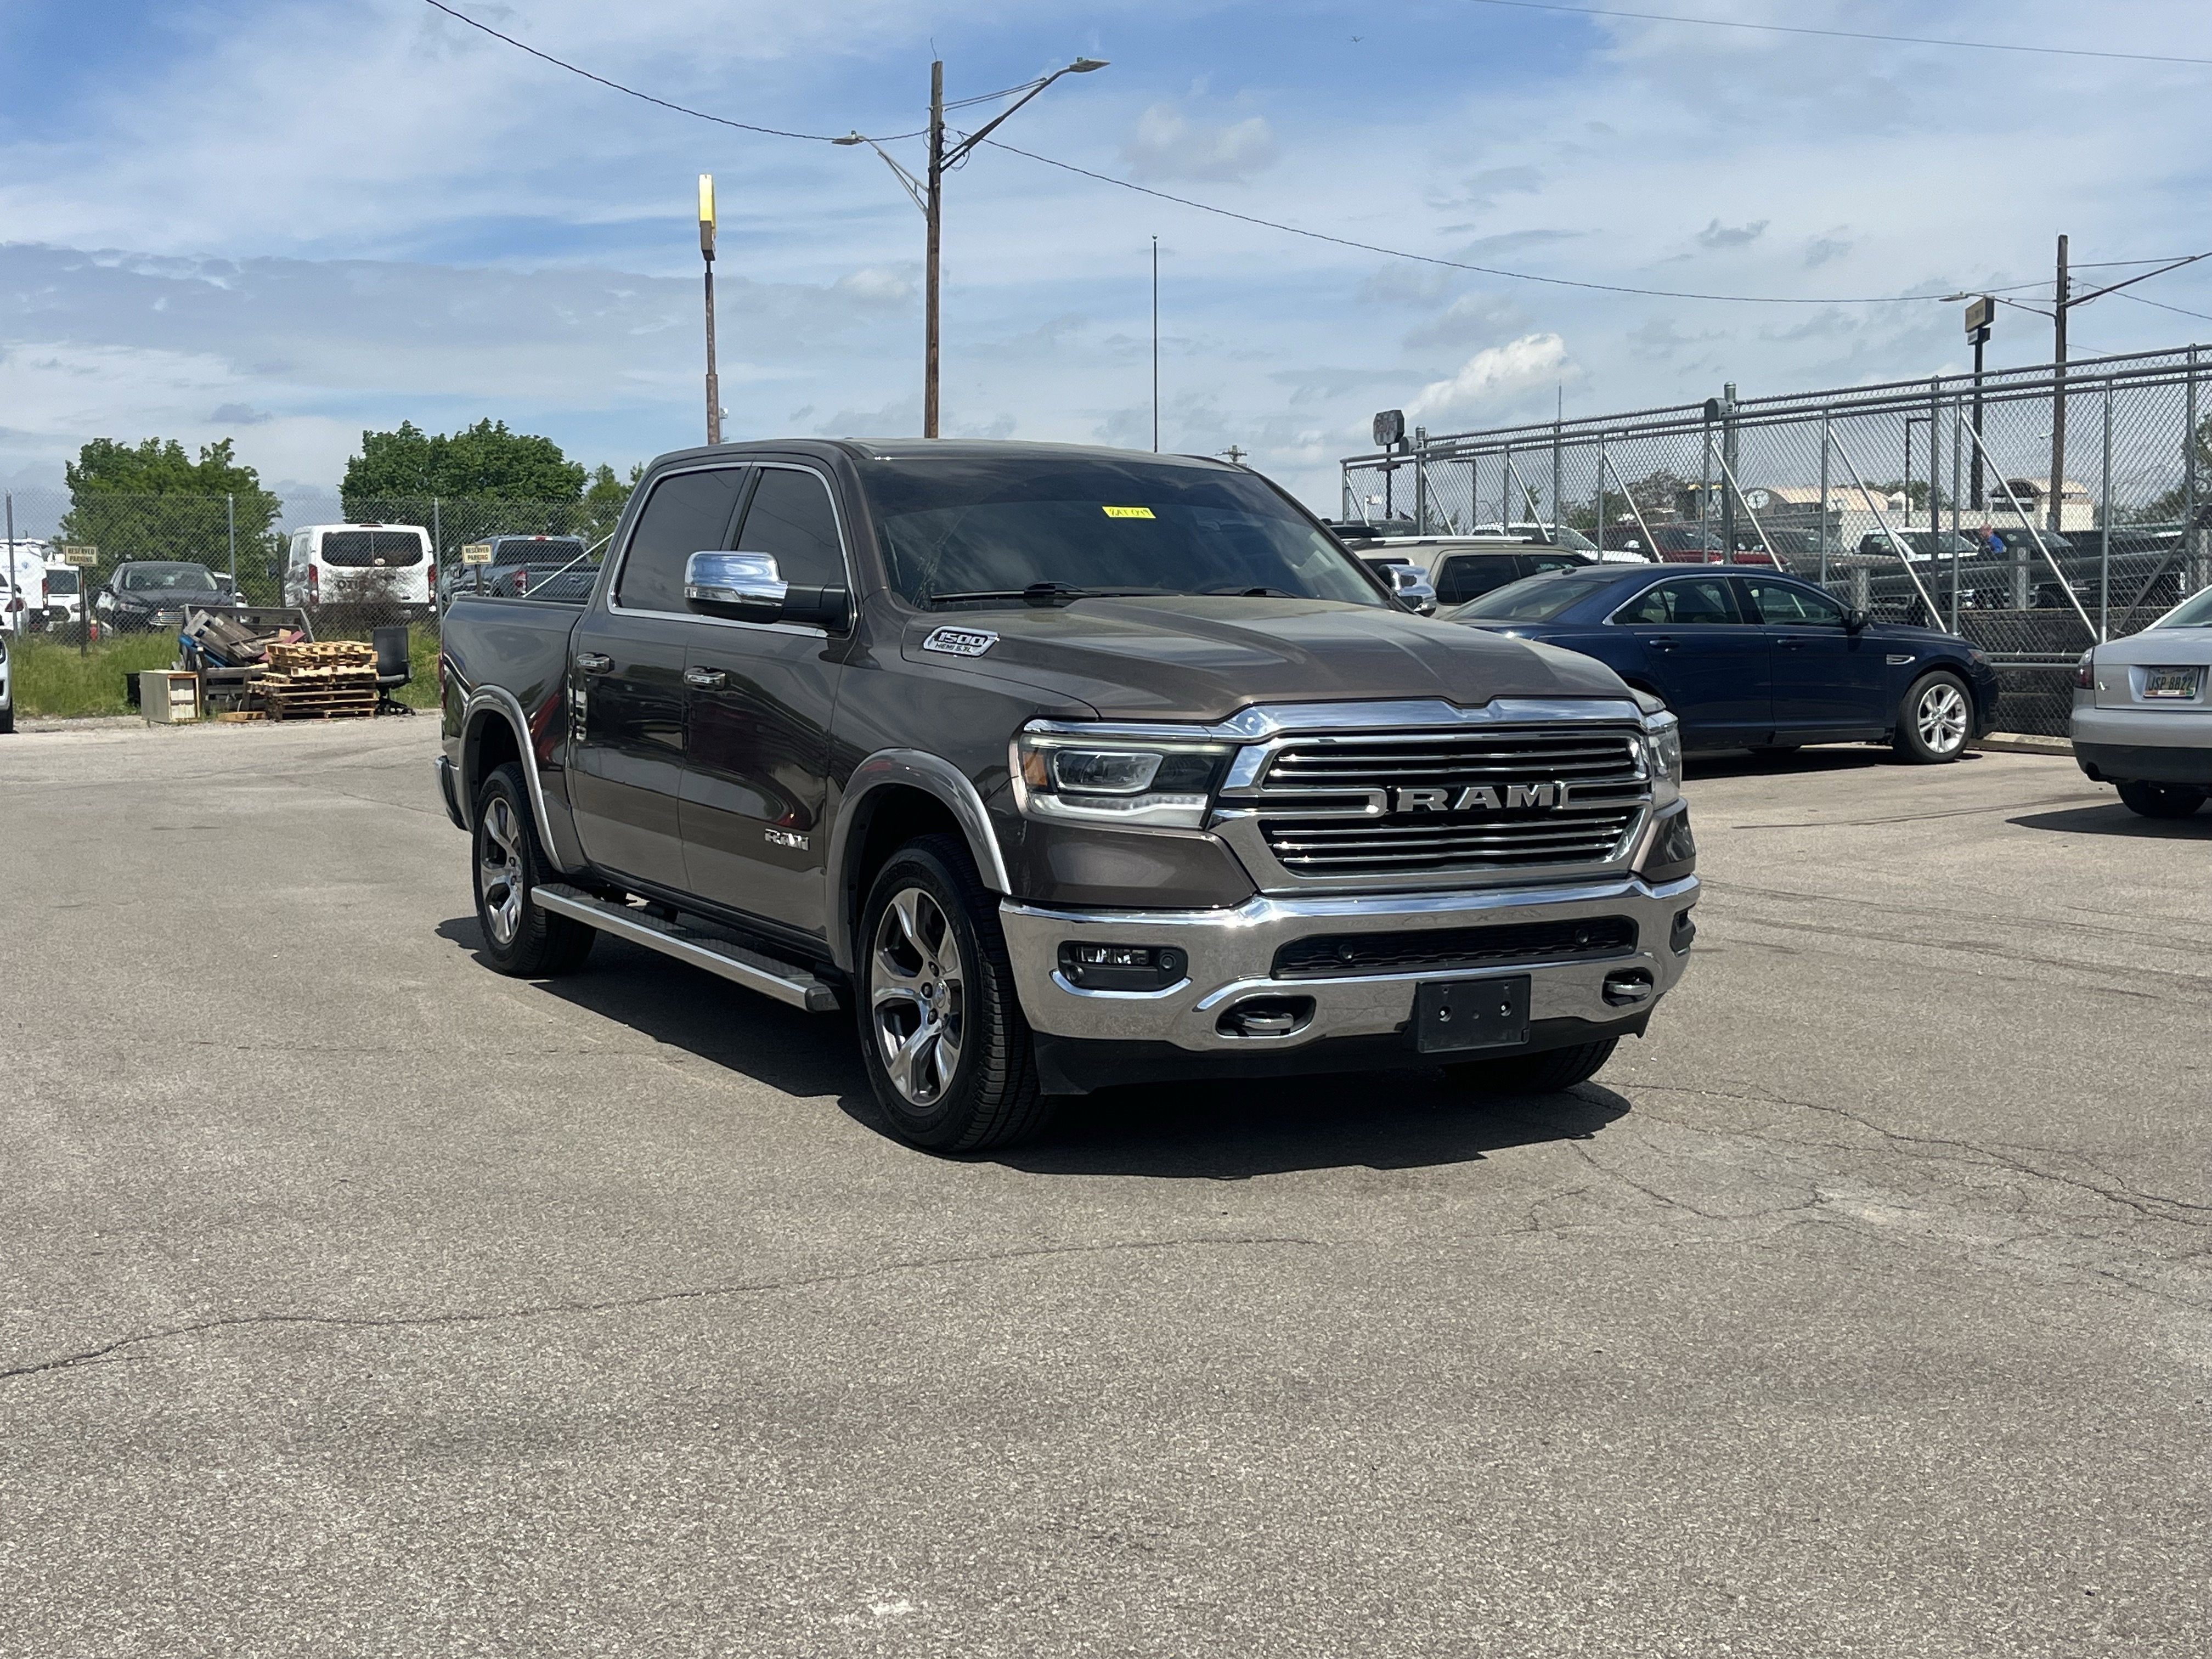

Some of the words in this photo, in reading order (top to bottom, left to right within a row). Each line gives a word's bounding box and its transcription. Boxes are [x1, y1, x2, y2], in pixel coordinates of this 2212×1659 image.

[938, 632, 986, 646] 1500
[935, 642, 955, 651] HEMI
[2148, 676, 2167, 690] JSP
[1396, 783, 1555, 812] RAM
[764, 828, 810, 851] RAM
